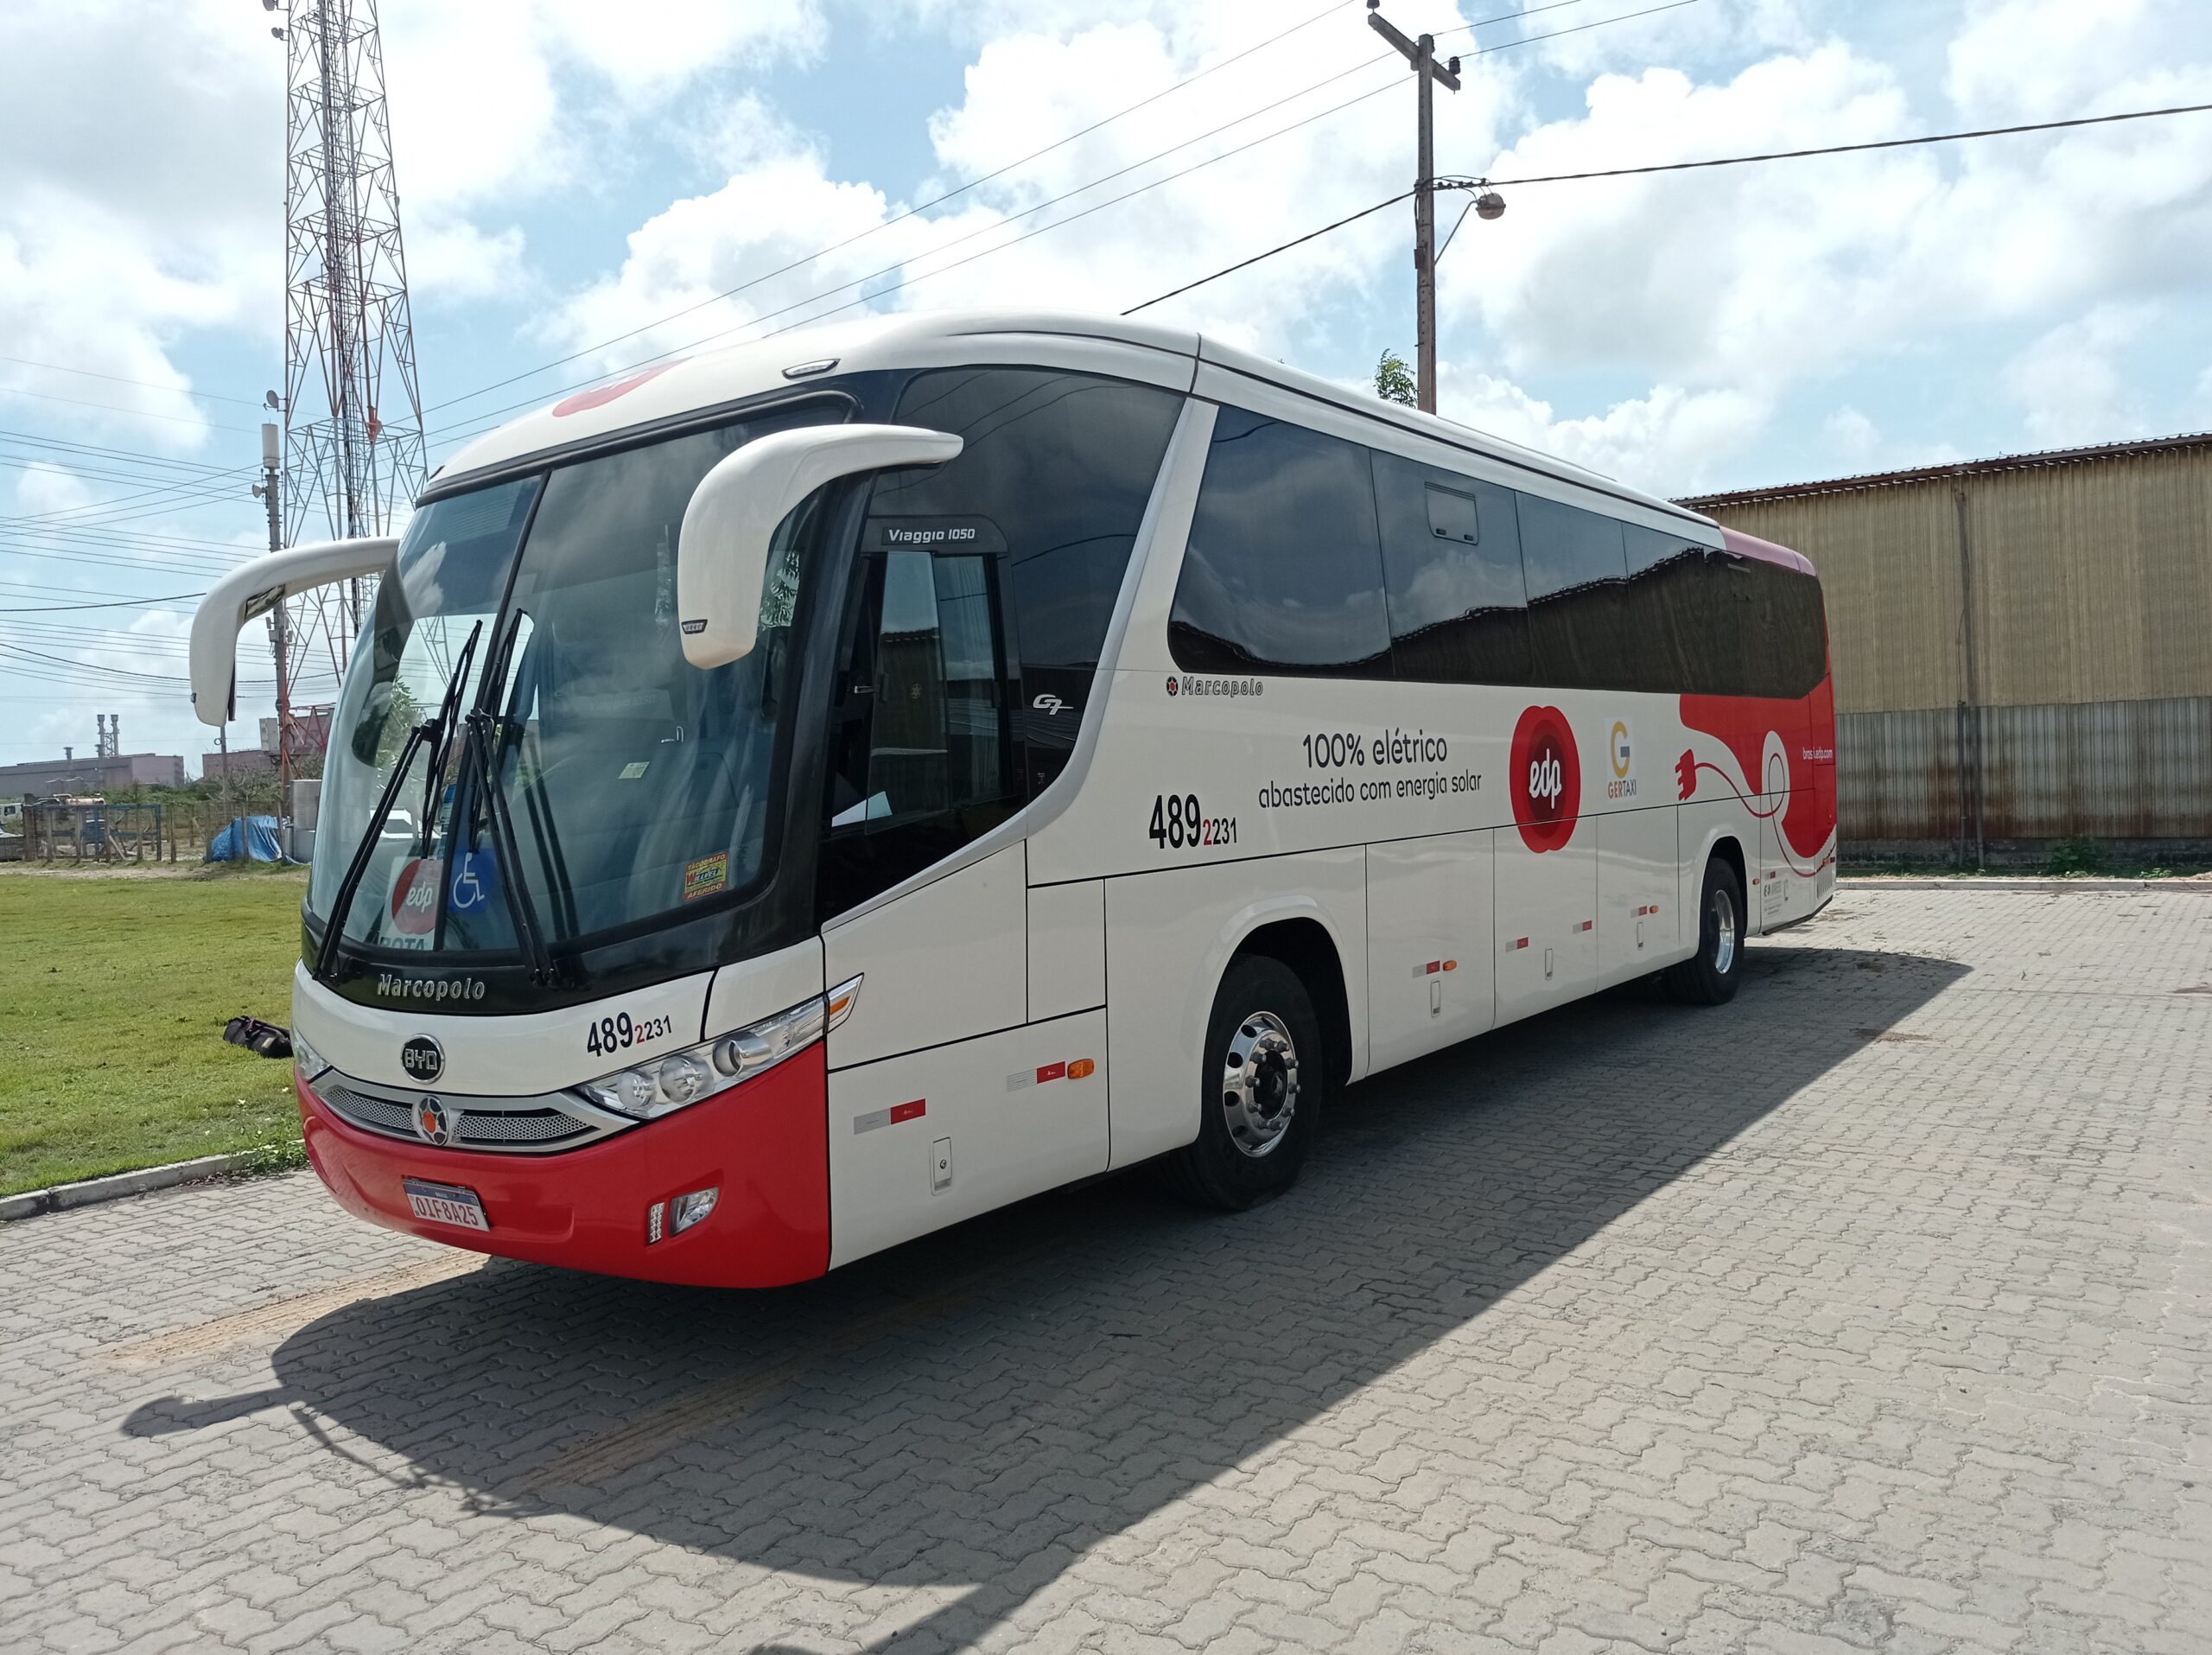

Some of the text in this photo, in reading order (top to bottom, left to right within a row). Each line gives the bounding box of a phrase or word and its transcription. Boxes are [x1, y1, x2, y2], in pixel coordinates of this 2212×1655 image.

[888, 528, 976, 544] Viaggio 1050
[1181, 676, 1263, 698] Marcopolo
[1303, 727, 1447, 768] 100% elétrico
[1258, 768, 1482, 808] abastecido com energia solar
[1529, 748, 1562, 810] edp
[1608, 779, 1637, 799] GERTAXI
[406, 881, 433, 913] edp
[686, 882, 723, 900] AFERIDO
[377, 973, 485, 1002] Marcopolo
[404, 1048, 438, 1071] BYD
